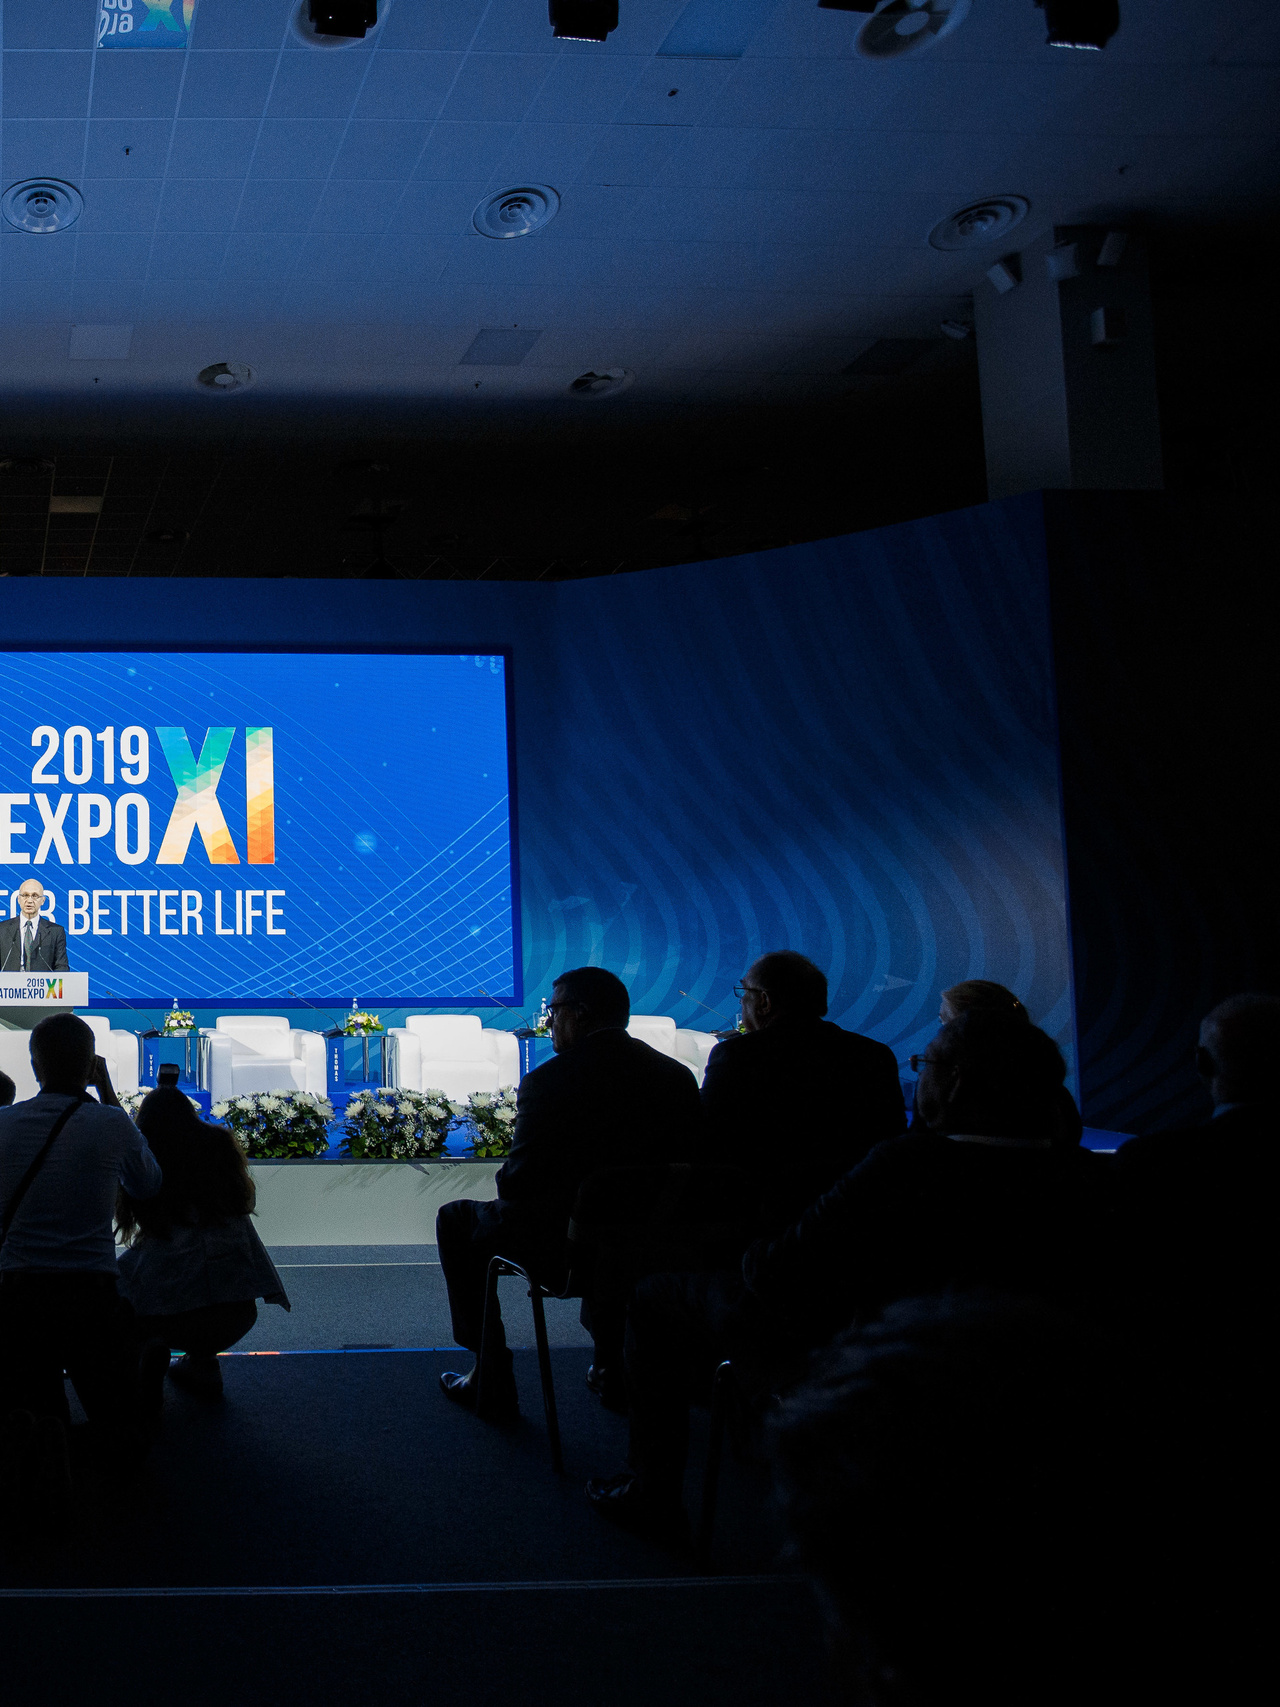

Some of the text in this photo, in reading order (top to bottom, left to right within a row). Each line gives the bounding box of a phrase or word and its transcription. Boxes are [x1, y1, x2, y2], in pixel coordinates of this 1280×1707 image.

[30, 725, 150, 785] 2019
[154, 726, 275, 864] XI
[68, 889, 204, 936] BETTER
[214, 889, 287, 936] LIFE
[26, 978, 45, 988] 2019
[45, 978, 63, 999] XI
